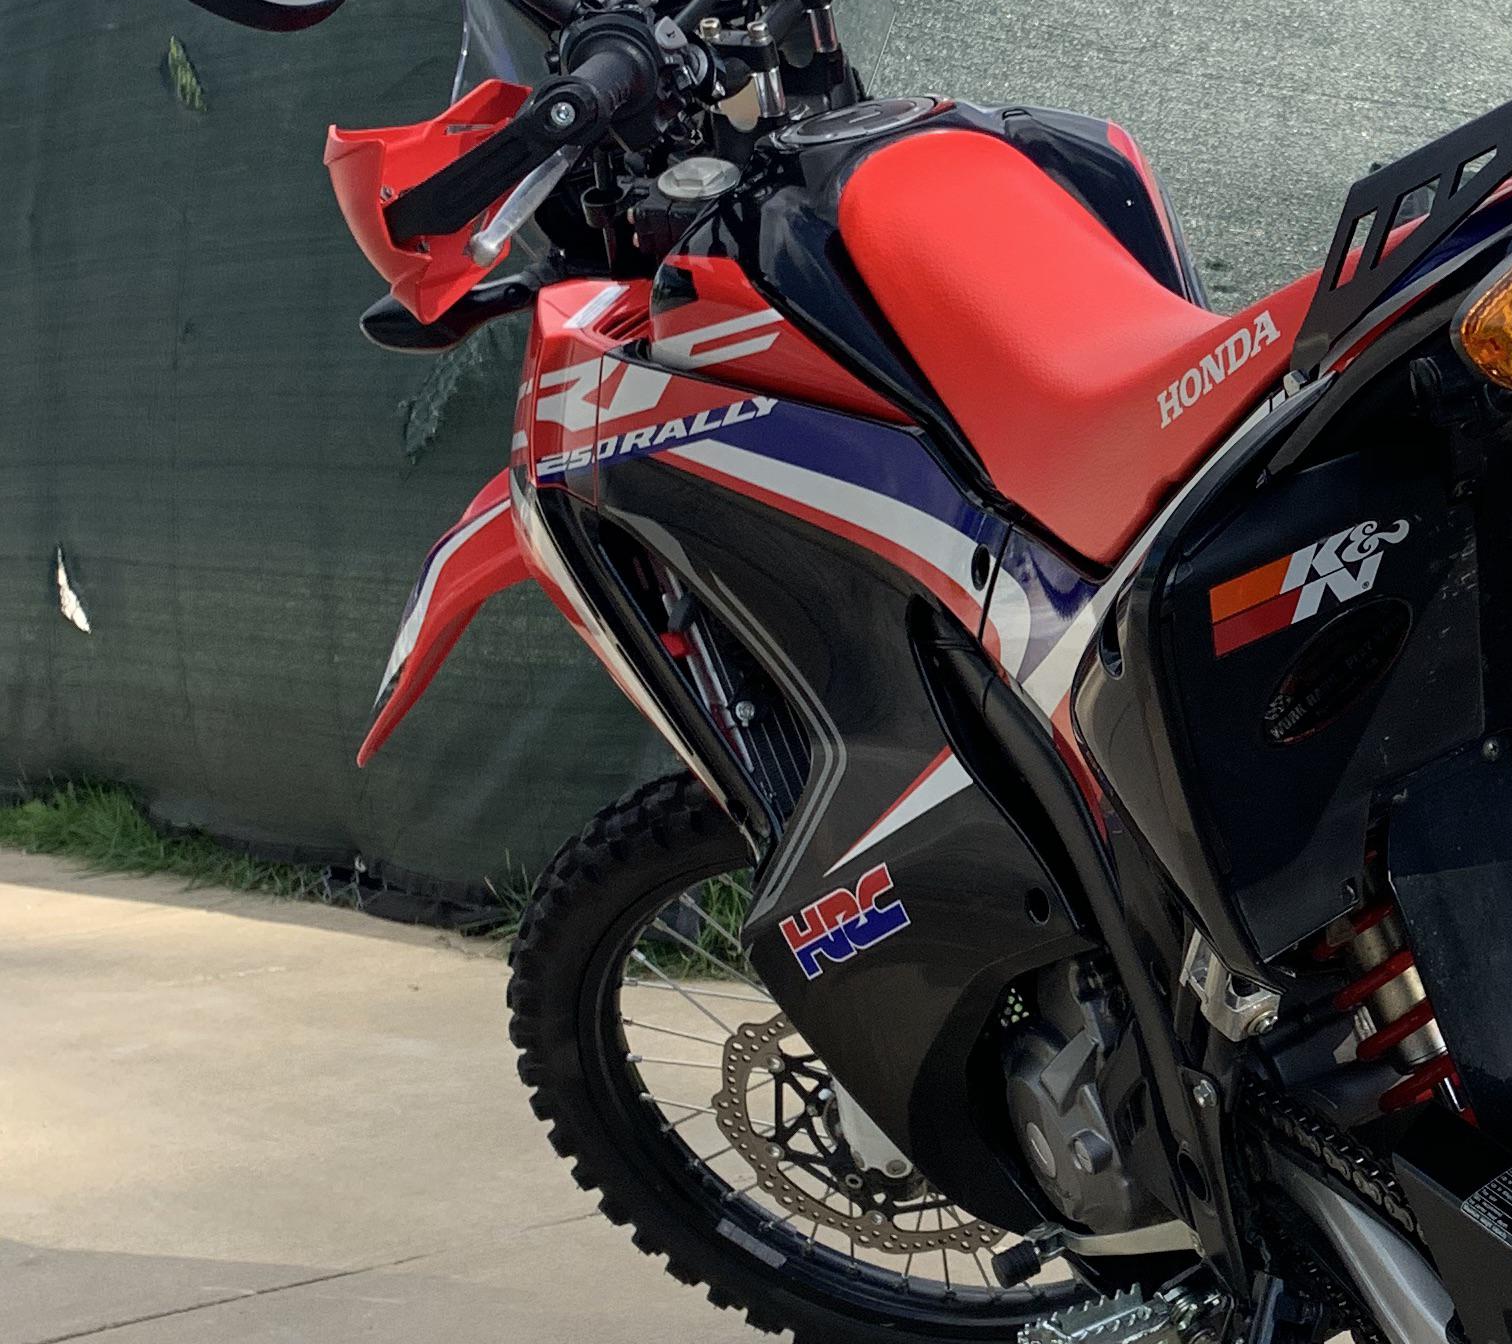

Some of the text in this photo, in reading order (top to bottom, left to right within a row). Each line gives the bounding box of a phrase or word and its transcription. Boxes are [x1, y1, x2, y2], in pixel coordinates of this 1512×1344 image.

[1155, 310, 1281, 430] HONDA
[536, 395, 779, 477] 250 RALLY
[778, 862, 911, 981] HRC
